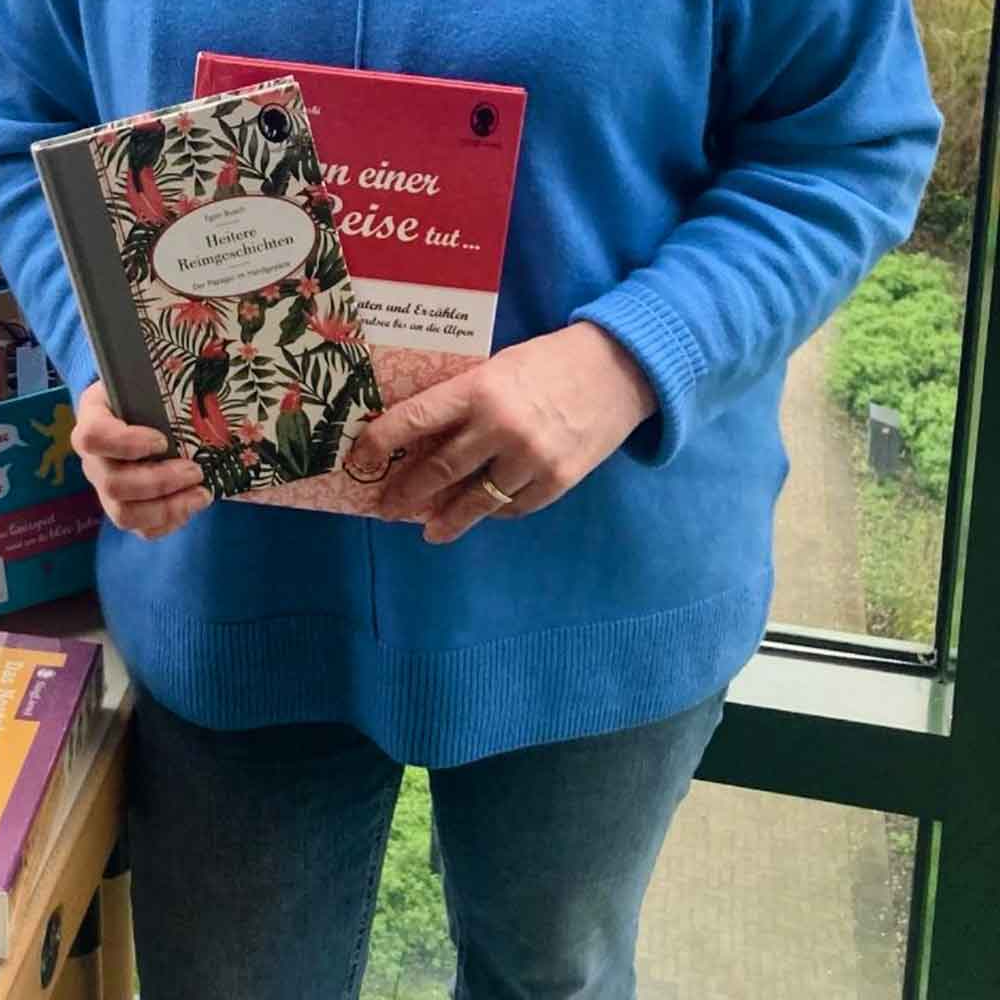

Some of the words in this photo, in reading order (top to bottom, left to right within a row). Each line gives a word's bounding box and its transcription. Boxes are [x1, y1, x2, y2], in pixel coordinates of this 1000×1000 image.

[358, 161, 440, 195] einer
[205, 228, 257, 248] Heitere
[177, 234, 294, 272] Reimgeschichten
[386, 303, 411, 314] und
[413, 304, 469, 320] Erzählen
[443, 325, 474, 338] Alpen
